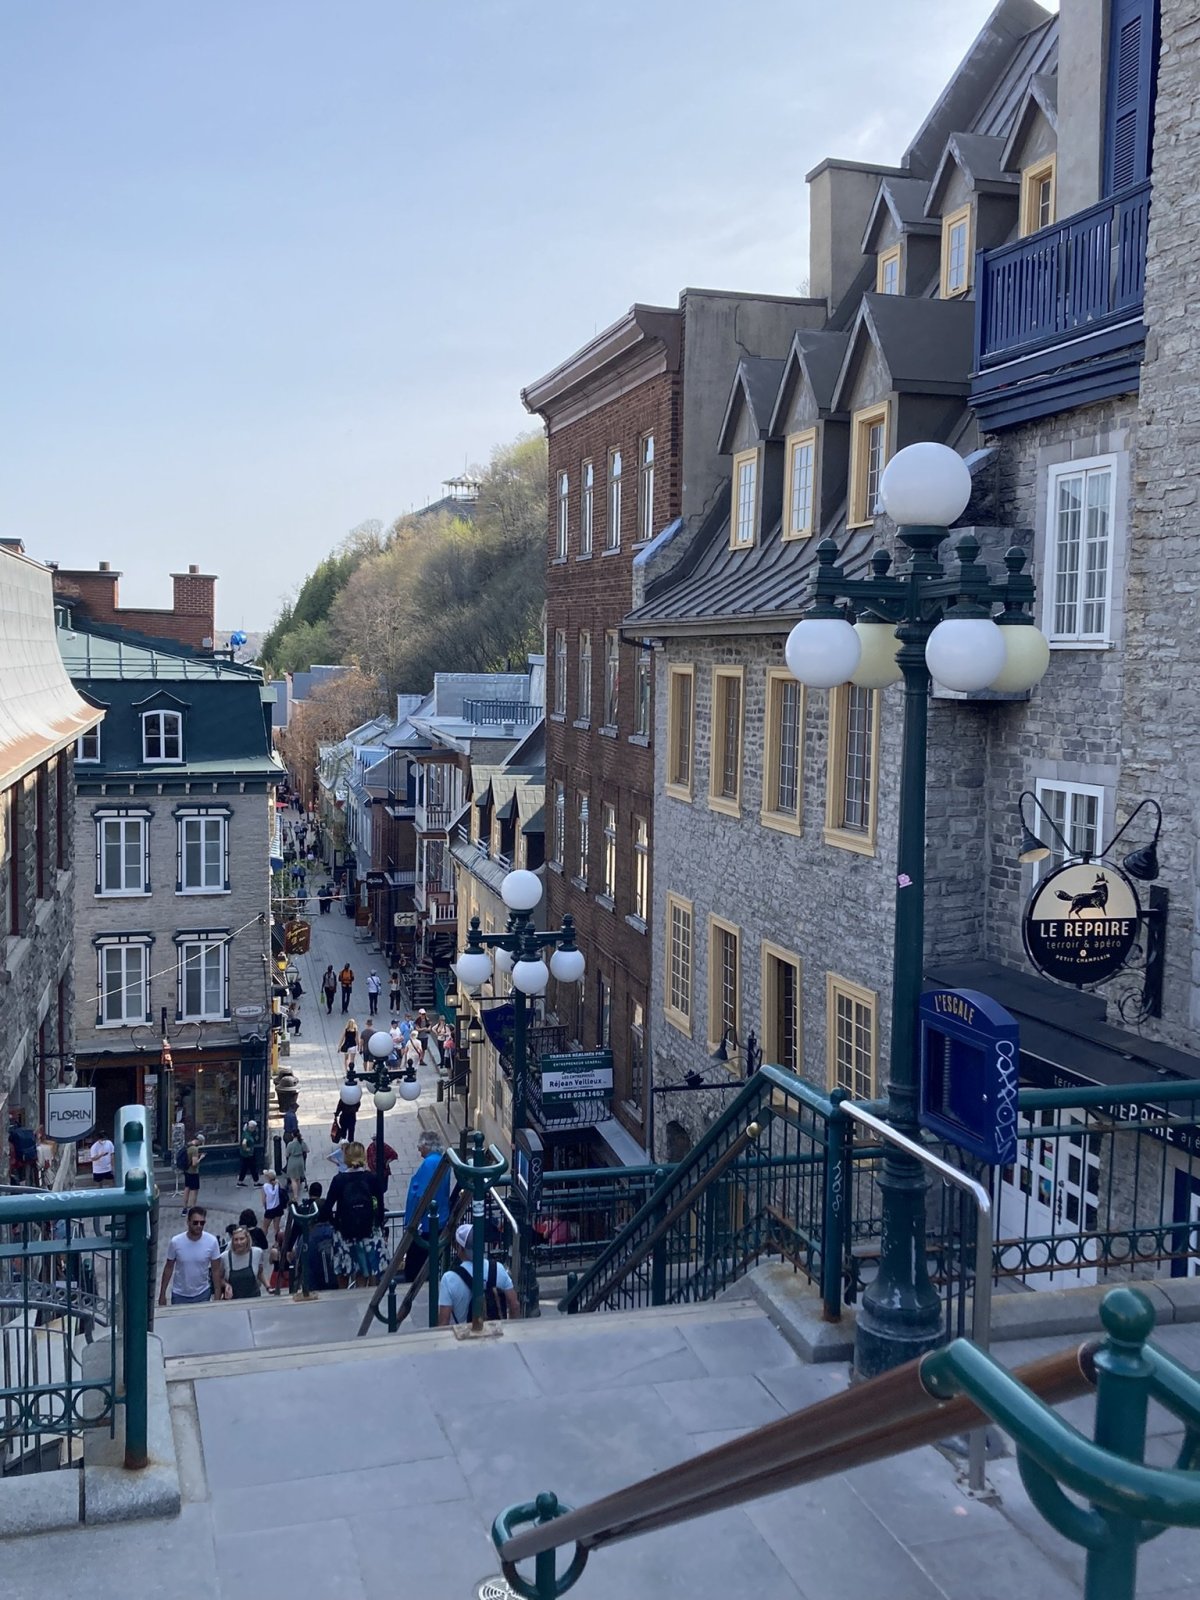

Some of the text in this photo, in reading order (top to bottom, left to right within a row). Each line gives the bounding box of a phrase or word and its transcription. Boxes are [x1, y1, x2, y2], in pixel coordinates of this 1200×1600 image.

[1040, 921, 1130, 938] LE REPAIRE
[1046, 939, 1121, 950] terroir & apéro
[1055, 953, 1111, 963] PETIT CHAMPLAIN
[934, 994, 975, 1025] L'ESCALE
[549, 1080, 573, 1088] Réjean
[574, 1078, 602, 1086] Veilleux
[50, 1109, 92, 1121] FLORIN
